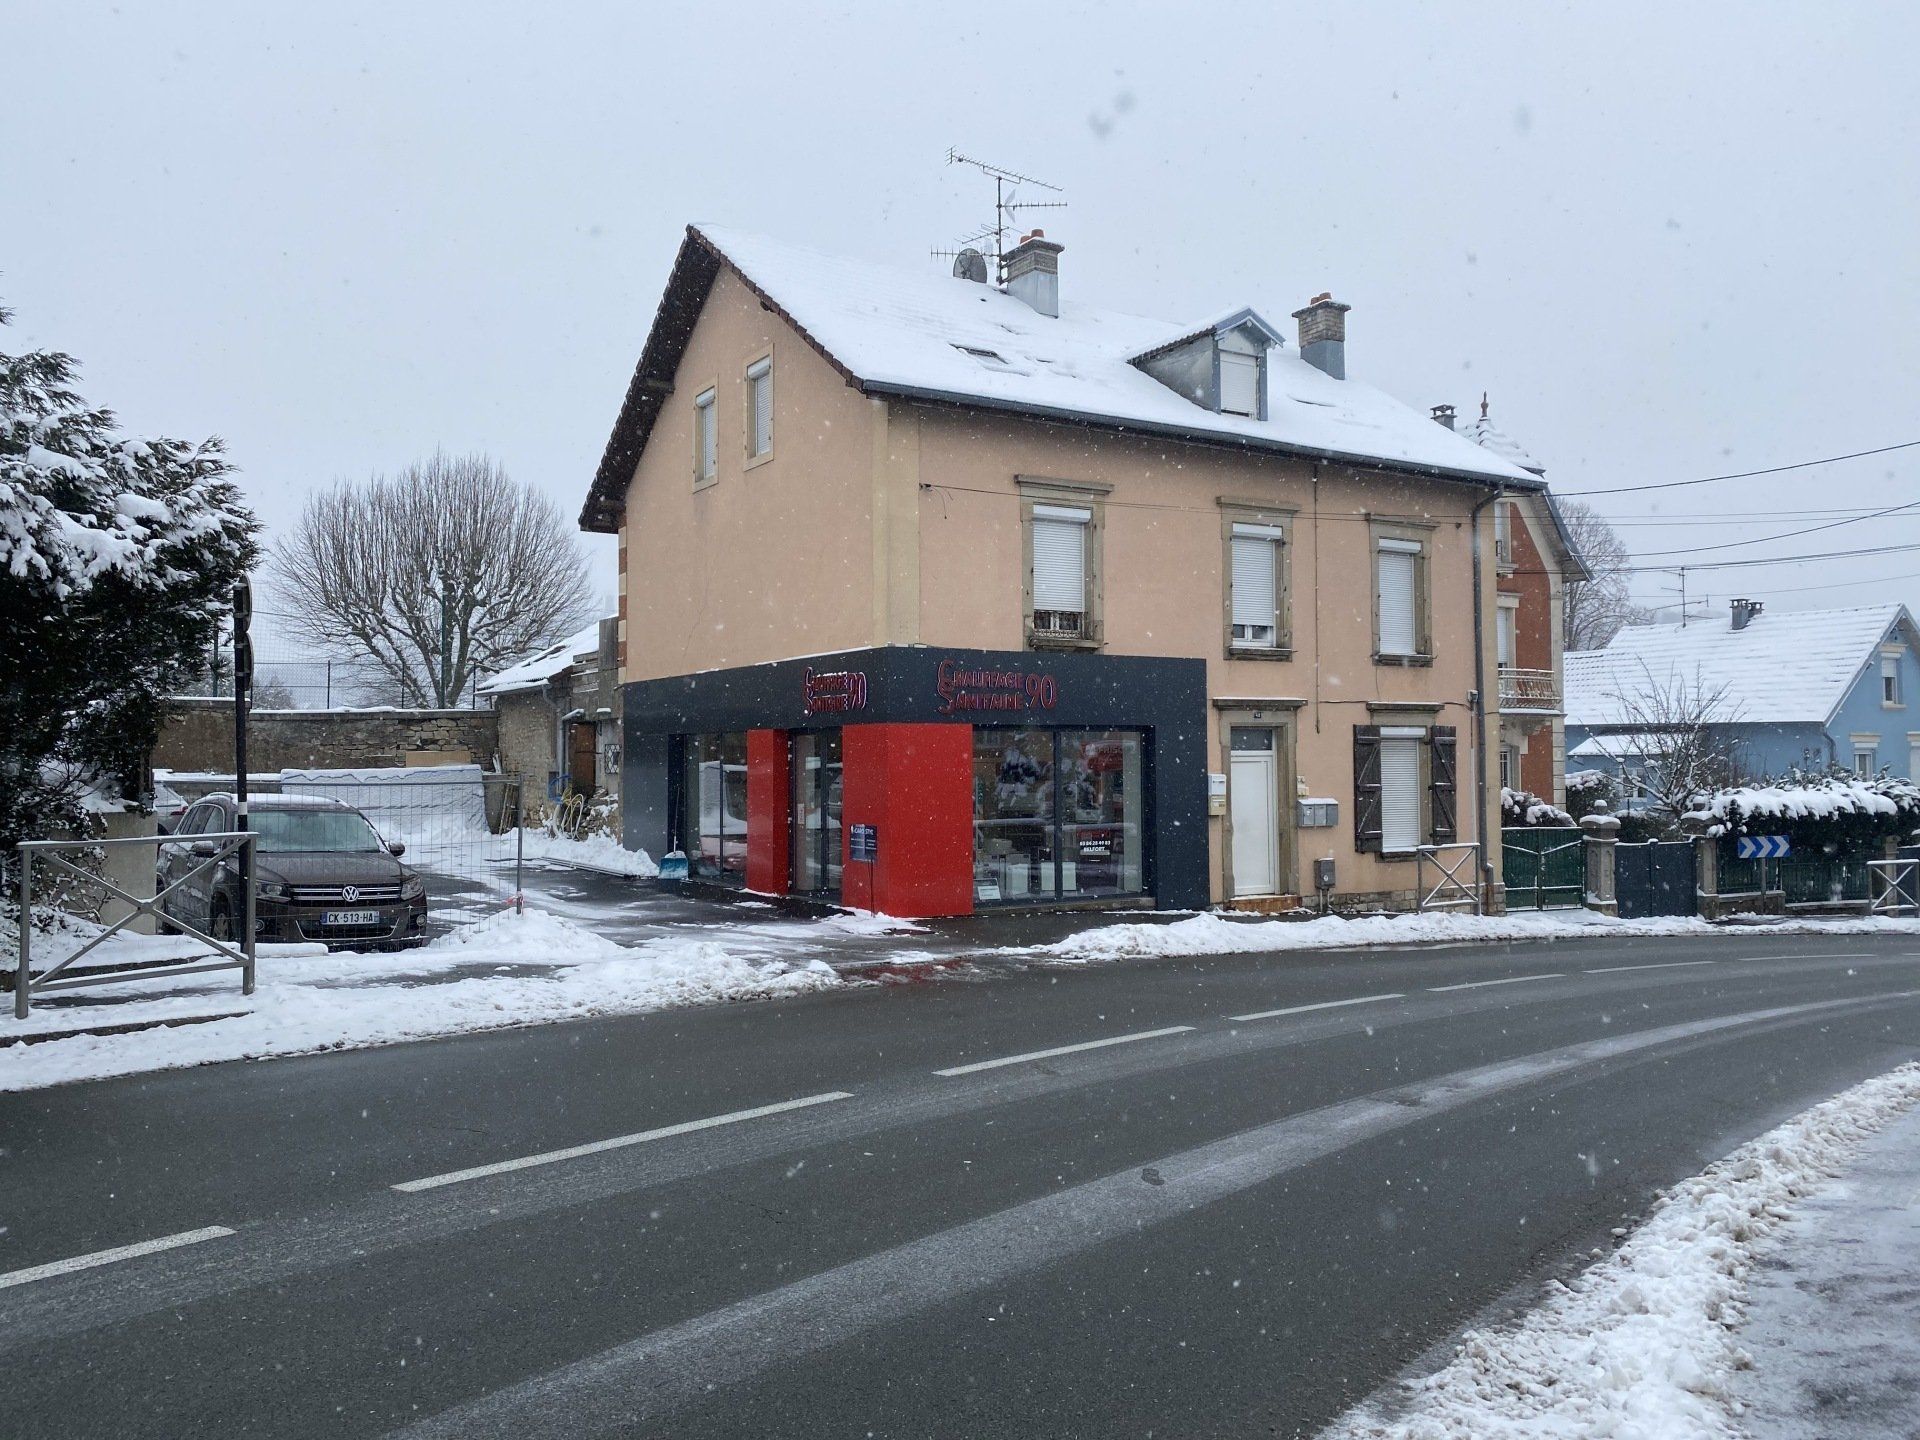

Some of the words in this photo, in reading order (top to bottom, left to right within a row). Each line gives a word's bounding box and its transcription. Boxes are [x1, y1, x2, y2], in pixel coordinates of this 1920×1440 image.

[848, 671, 867, 710] 90
[937, 685, 1024, 715] SANITAIRE
[1026, 672, 1057, 710] 90
[328, 913, 374, 923] CK-513-HA
